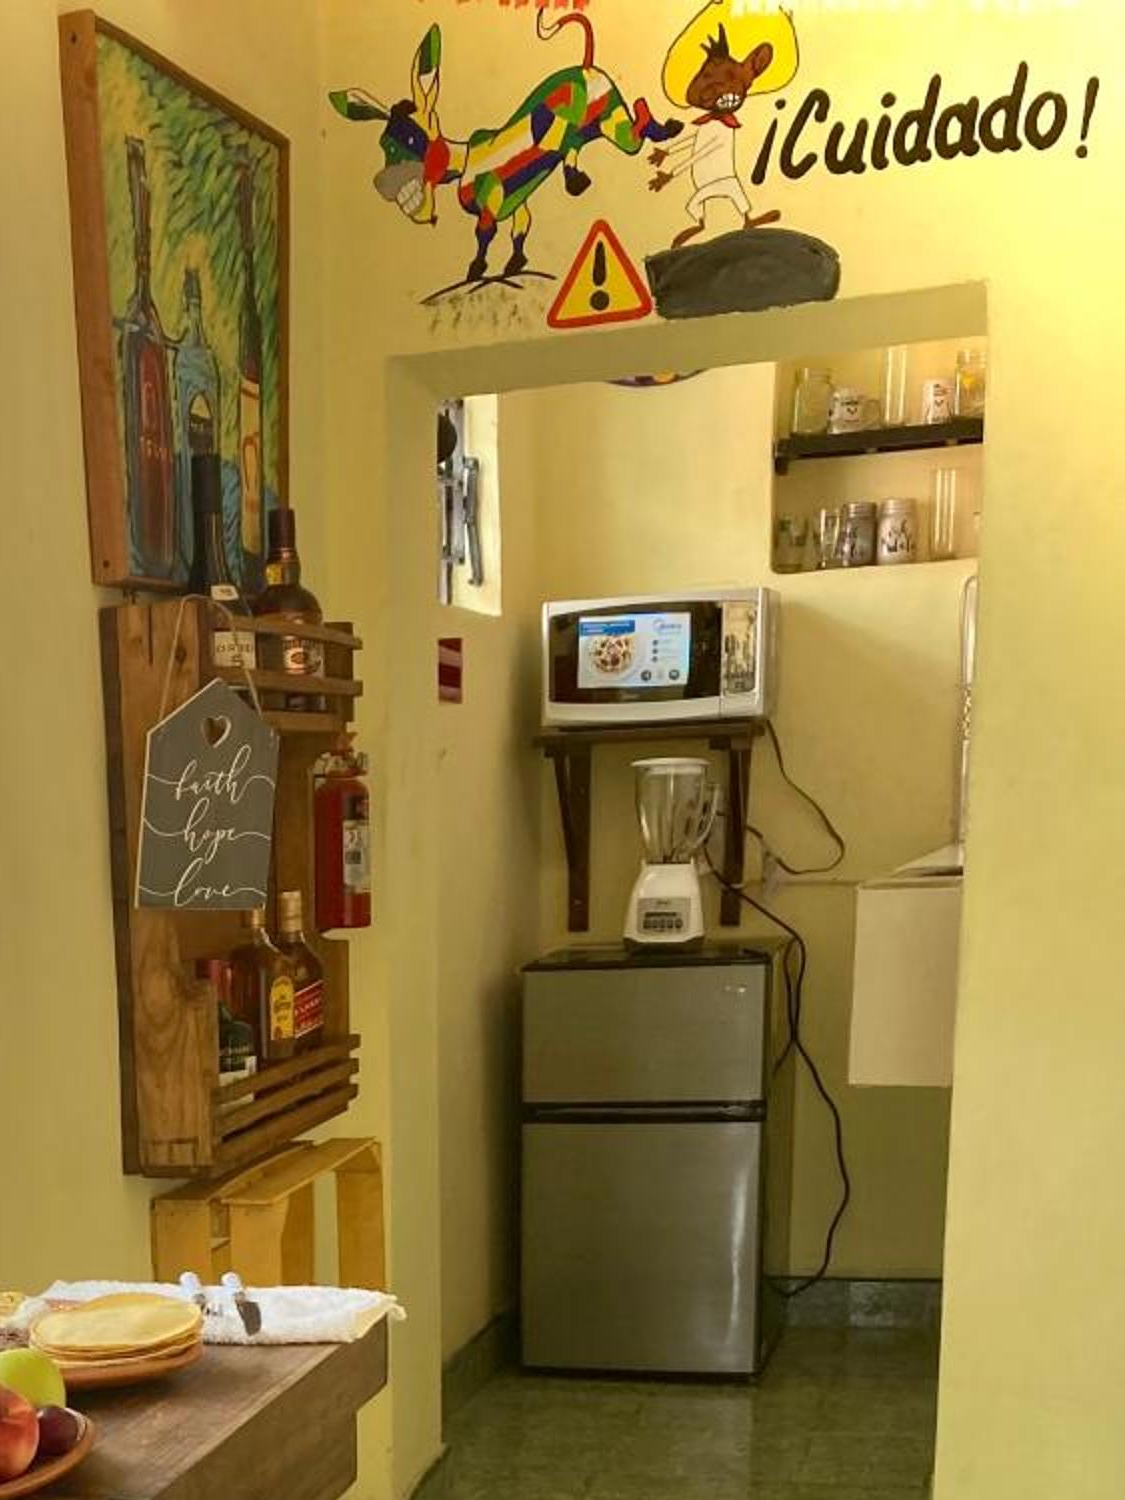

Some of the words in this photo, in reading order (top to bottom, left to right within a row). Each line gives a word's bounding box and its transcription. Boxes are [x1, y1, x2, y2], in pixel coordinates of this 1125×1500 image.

[751, 60, 1100, 185] ¡Cuidado!
[173, 743, 259, 805] faith
[177, 796, 245, 865] hope
[170, 857, 241, 908] love
